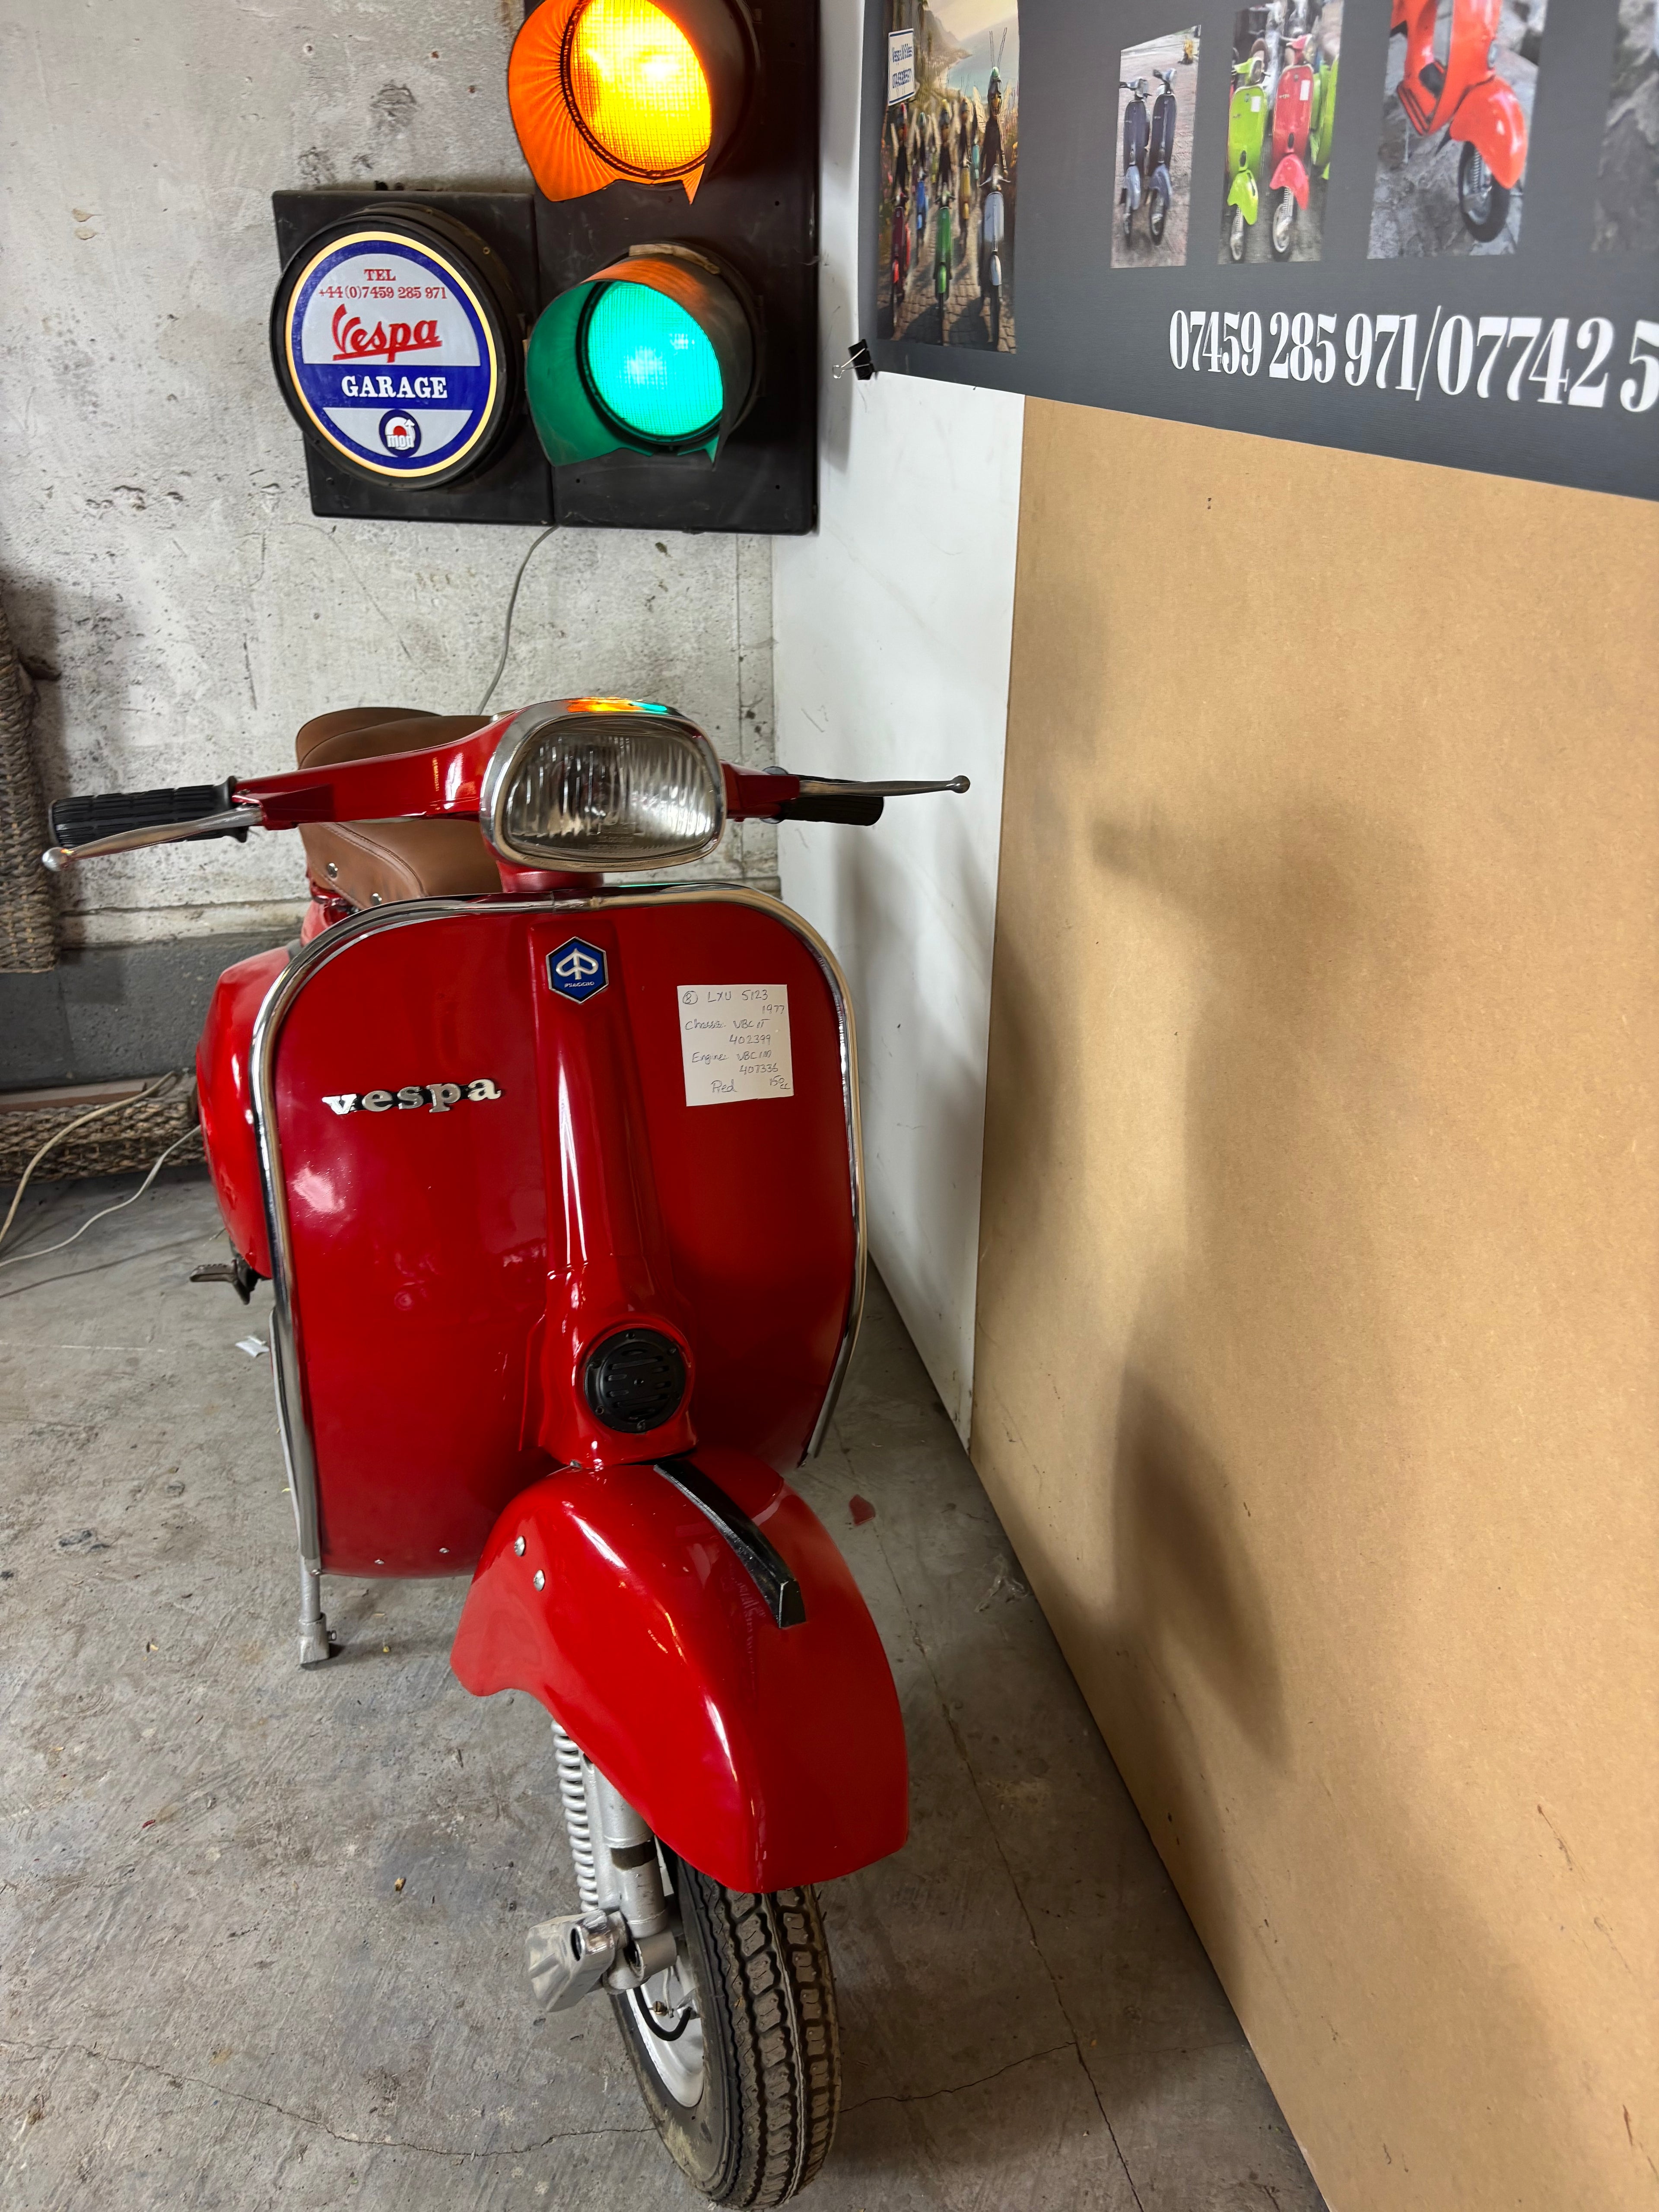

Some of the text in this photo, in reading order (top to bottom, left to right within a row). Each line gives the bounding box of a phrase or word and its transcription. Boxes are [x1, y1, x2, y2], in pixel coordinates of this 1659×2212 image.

[363, 269, 396, 281] TEL
[397, 287, 421, 299] 285
[425, 287, 447, 299] 971
[331, 303, 442, 363] Vespa
[1170, 310, 1262, 376] 07459
[1269, 312, 1337, 382] 285
[1620, 319, 1659, 412] 5
[341, 375, 448, 399] GARAGE
[742, 989, 768, 1000] 5123
[763, 1004, 785, 1014] 1977
[729, 1034, 771, 1045] 402399
[711, 1079, 737, 1093] Red
[321, 1079, 501, 1115] vespa
